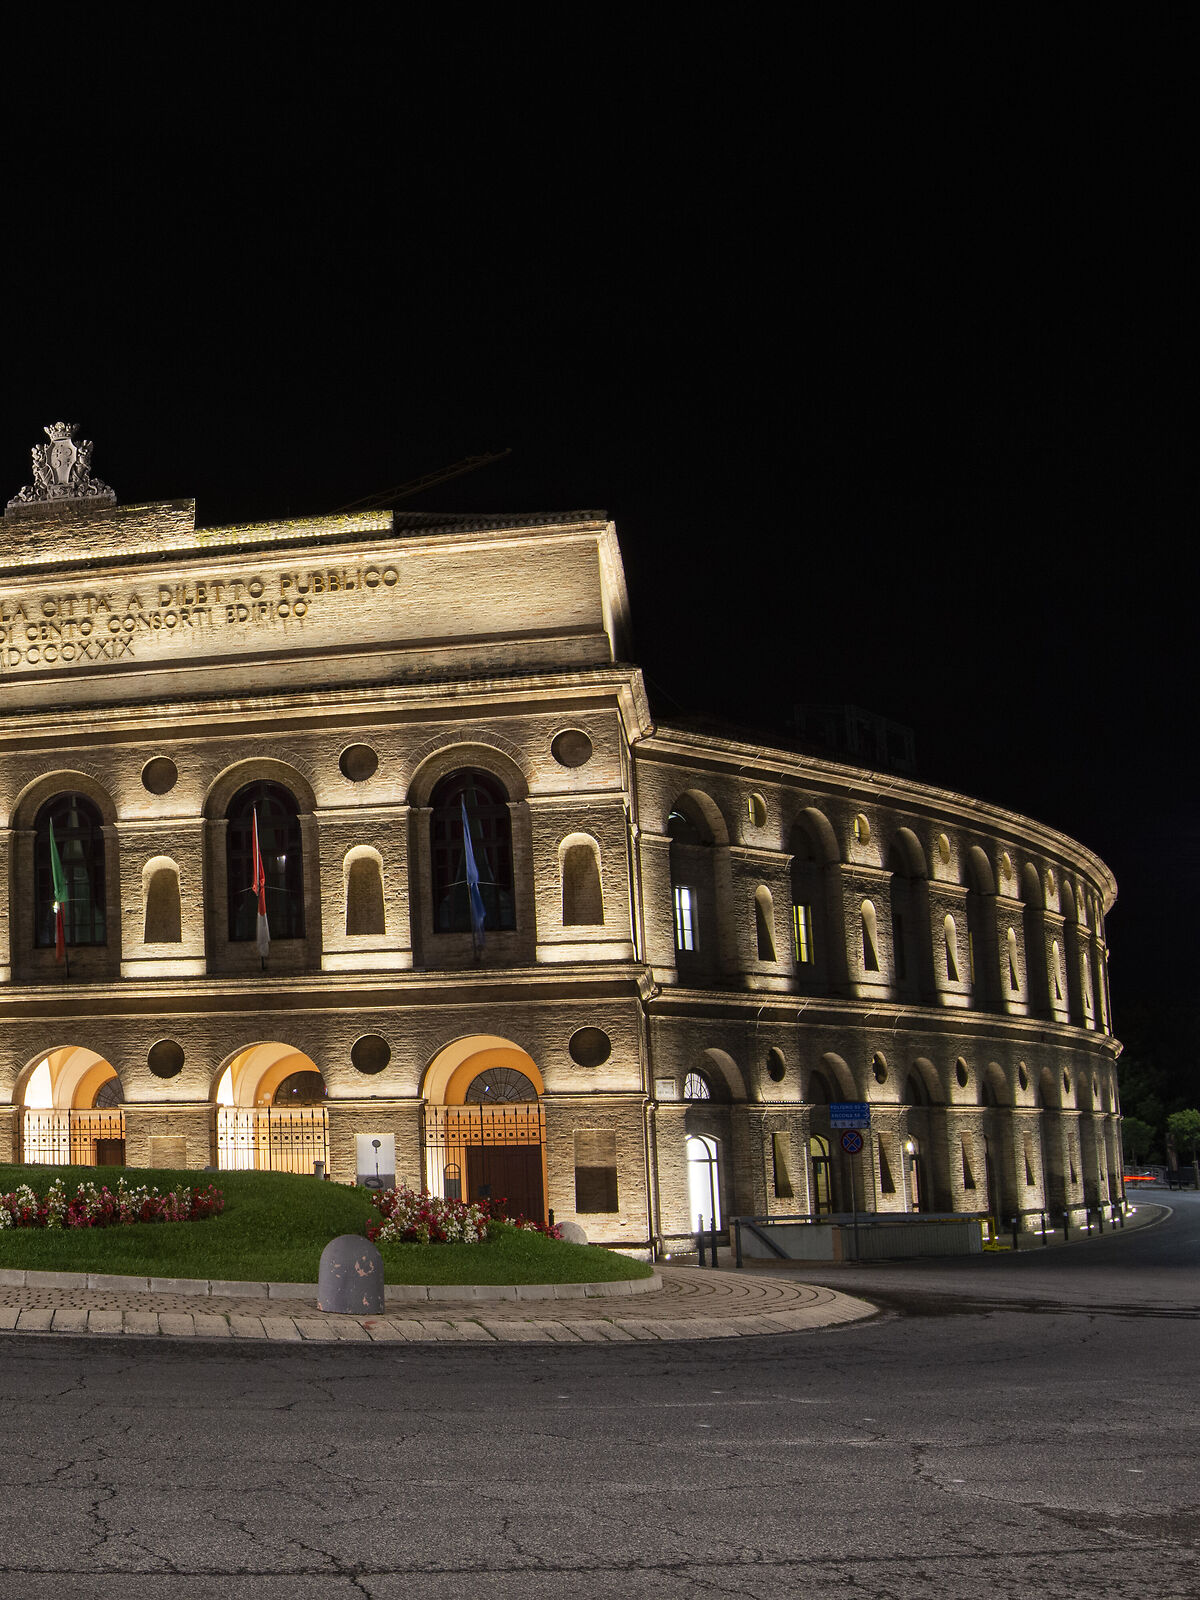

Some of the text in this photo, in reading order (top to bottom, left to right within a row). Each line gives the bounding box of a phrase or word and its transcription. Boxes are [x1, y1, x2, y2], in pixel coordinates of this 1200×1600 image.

[127, 591, 144, 611] A
[157, 578, 265, 607] DILETTO
[280, 568, 400, 597] PUBBLICO
[25, 619, 93, 642] CENTO
[108, 607, 213, 634] CONSORTI
